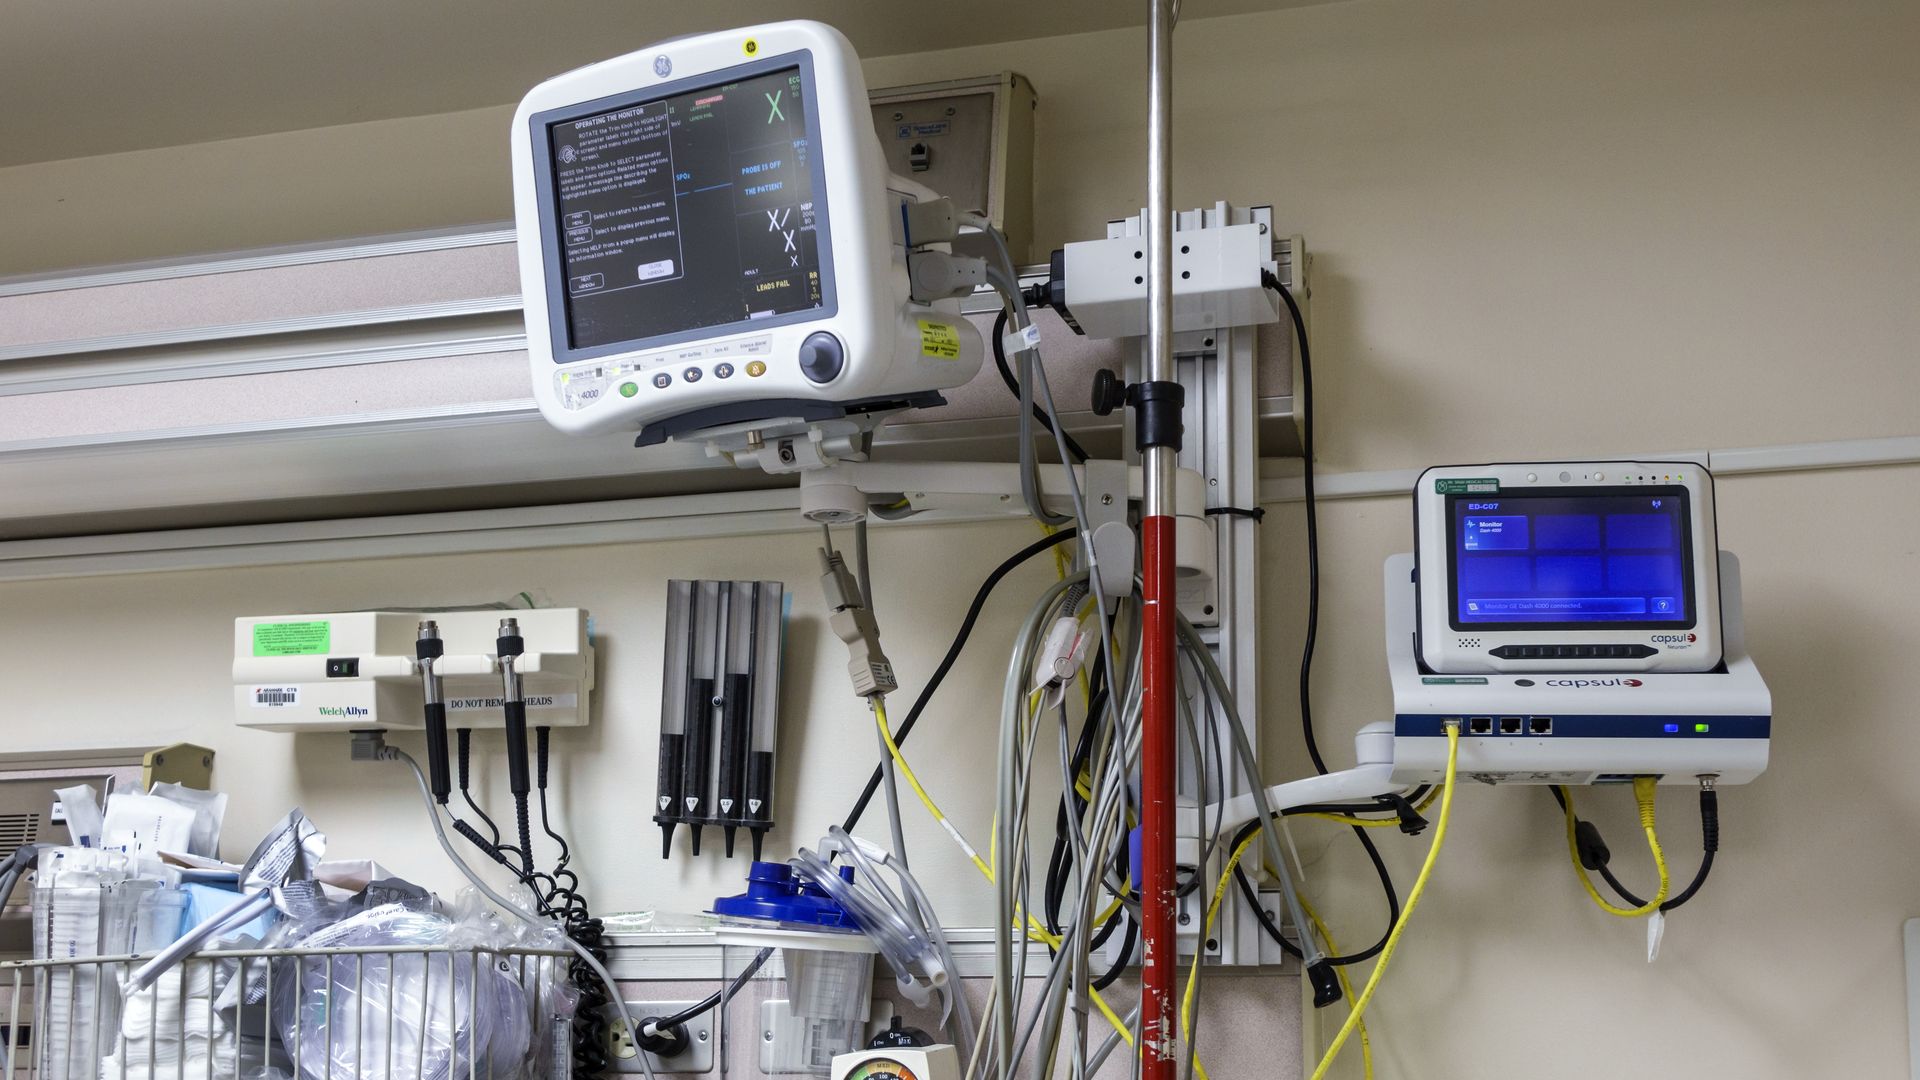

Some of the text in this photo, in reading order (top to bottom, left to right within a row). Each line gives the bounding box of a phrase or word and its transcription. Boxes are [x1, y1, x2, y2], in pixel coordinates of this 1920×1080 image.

[575, 108, 644, 129] OPERATING THE MONITOR
[579, 130, 599, 139] ROTATE
[641, 114, 667, 125] HIGHLIGHT
[580, 136, 605, 147] parameter
[606, 133, 619, 141] labels
[622, 137, 640, 145] options
[560, 170, 575, 178] PRESS
[617, 157, 634, 166] SELECT
[636, 151, 662, 162] parameter
[561, 178, 574, 186] labels
[585, 173, 597, 181] menu
[637, 162, 649, 170] menu
[650, 158, 669, 167] options
[742, 160, 782, 175] PROBE IS OFF
[593, 177, 613, 186] message
[624, 170, 648, 180] describing
[562, 190, 587, 200] highlighted
[588, 187, 601, 195] menu
[602, 184, 617, 192] option
[744, 182, 784, 196] THE PATIENT
[616, 208, 631, 216] return
[595, 228, 610, 236] Select
[618, 223, 634, 231] display
[635, 219, 655, 228] previous
[568, 247, 589, 256] Selecting
[620, 238, 634, 246] popup
[658, 230, 675, 239] display
[576, 252, 604, 262] information
[756, 280, 790, 292] LEADS FAIL
[581, 389, 599, 399] 4000
[451, 699, 463, 709] DO
[465, 698, 483, 708] NOT
[524, 696, 553, 707] HEADS
